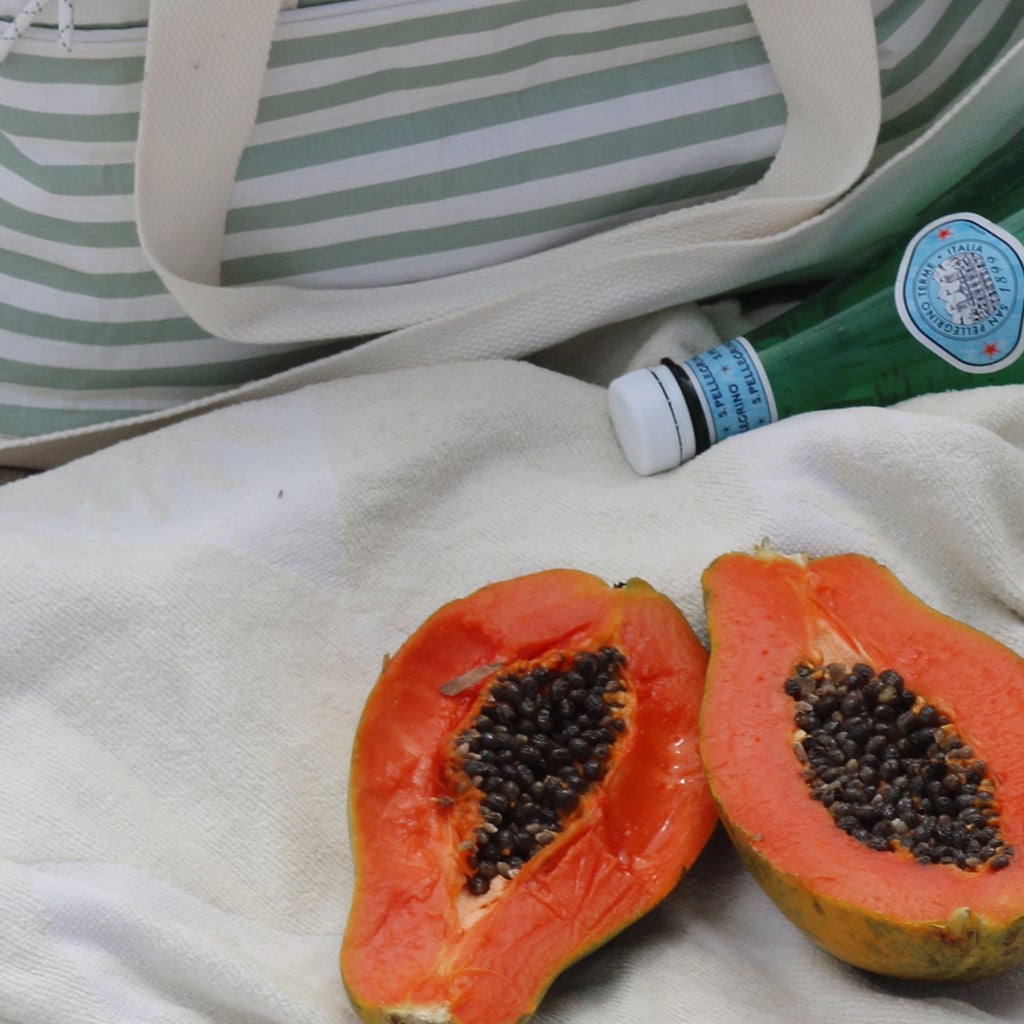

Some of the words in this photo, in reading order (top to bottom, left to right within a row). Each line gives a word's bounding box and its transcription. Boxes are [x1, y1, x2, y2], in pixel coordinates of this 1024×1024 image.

[947, 244, 983, 255] ITALIA
[918, 263, 934, 297] TERME
[987, 255, 1011, 293] 1899
[922, 302, 986, 336] PELLEGRINO
[990, 304, 1008, 327] SAN
